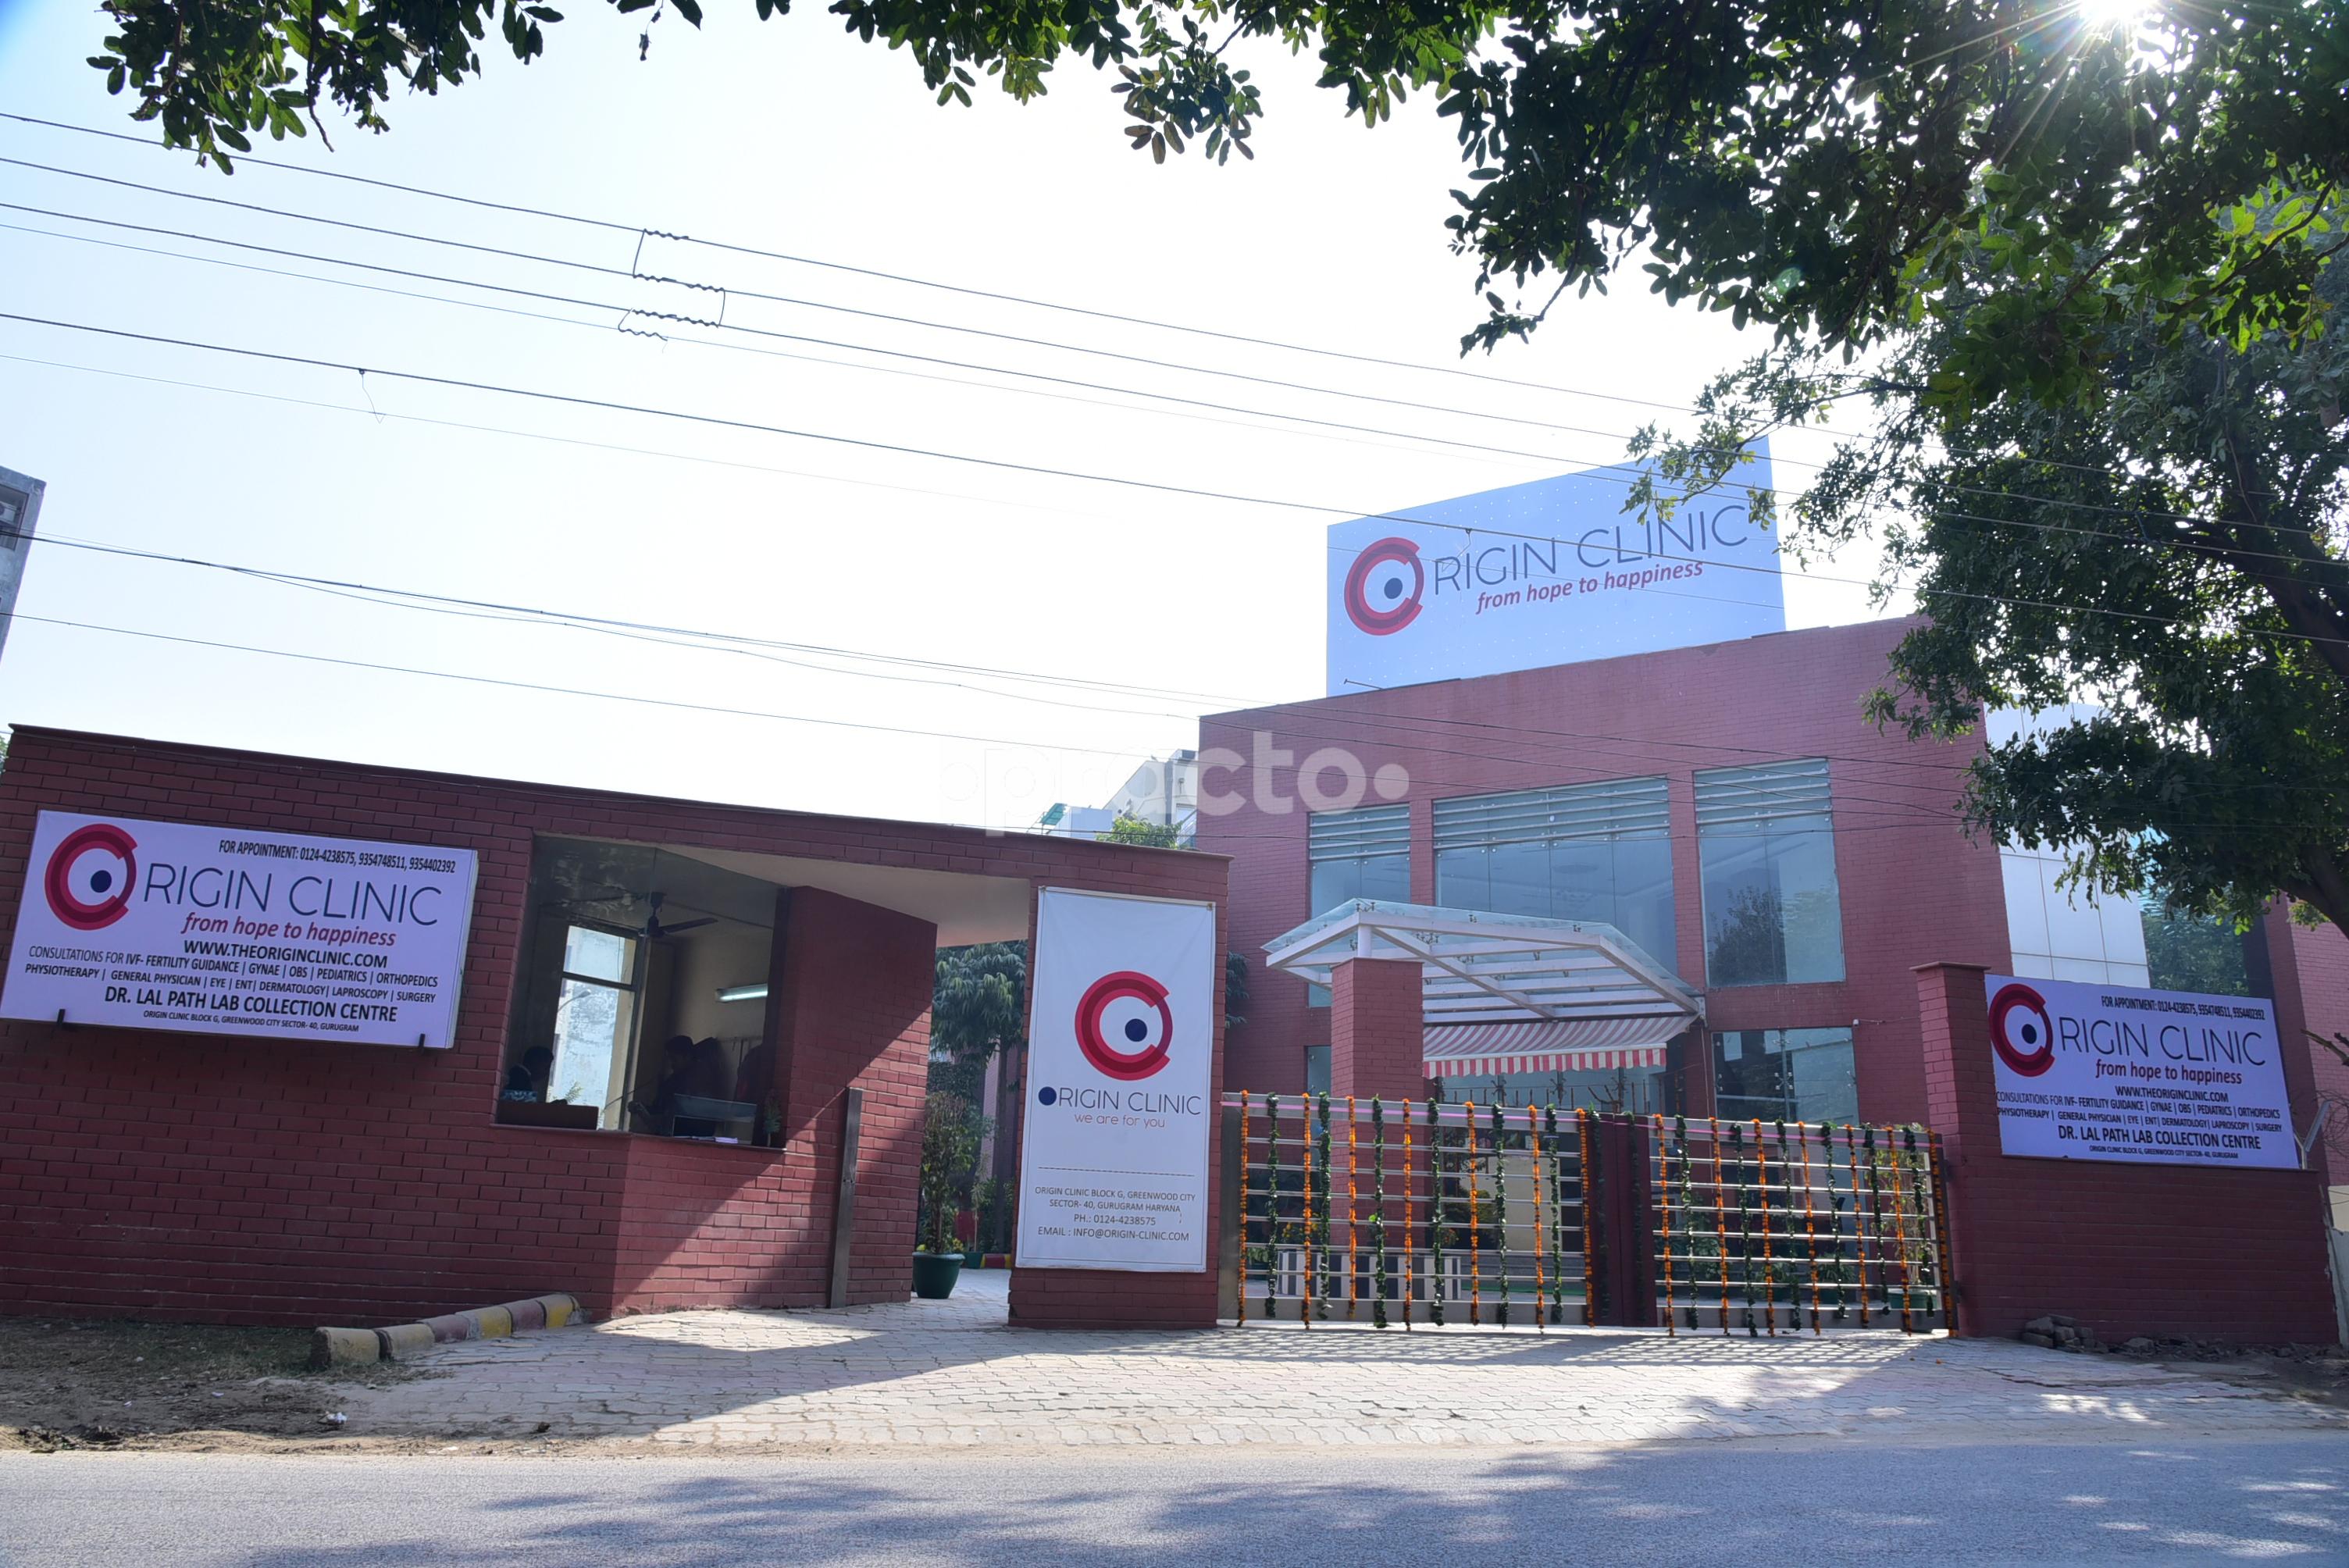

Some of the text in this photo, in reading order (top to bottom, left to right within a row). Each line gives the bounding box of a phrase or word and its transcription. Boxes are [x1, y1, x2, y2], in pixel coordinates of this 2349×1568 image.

[1577, 505, 1748, 568] CLINIC
[1475, 561, 1703, 615] from hope to happiness
[219, 839, 456, 874] FOR APPOINTMENT: 0124-4238575, 9354748511, 9354402392
[289, 875, 442, 926] CLINIC
[180, 911, 397, 947] from hope to happiness
[29, 945, 104, 963] CONSULTATIONS
[105, 951, 124, 964] FOR
[125, 953, 144, 965] IVF-
[145, 954, 191, 969] FERTILITY
[191, 957, 241, 973] GUIDANCE
[248, 963, 280, 976] GYNAE
[289, 965, 308, 978] OBS
[316, 968, 368, 982] PEDIATRICS
[376, 972, 438, 988] ORTHOPEDICS
[184, 939, 388, 969] WWW.THEORIGINCLINIC.COM
[25, 963, 100, 978] PHYSIOTHERAPY
[111, 970, 152, 983] GENERAL
[153, 973, 201, 986] PHYSICIAN
[209, 977, 226, 989] EYE
[332, 986, 389, 1000] LAPROSCOPY
[396, 991, 437, 1003] SURGERY
[105, 985, 398, 1022] DR. LAL PATH LAB COLLECTION CENTRE
[143, 1010, 359, 1032] ORIGIN CLINIC BLOCK G, GREENWOOD CITY SECTOR- 40, GURUGRAM
[2159, 1025, 2266, 1066] CLINIC
[2095, 1058, 2242, 1085] from hope to happiness
[1128, 1092, 1201, 1116] CLINIC
[1996, 1091, 2049, 1105] CONSULTATIONS
[2049, 1095, 2063, 1106] FOR
[2063, 1096, 2078, 1107] IVF-
[2078, 1096, 2109, 1108] FERTILITY
[2110, 1099, 2144, 1111] GUIDANCE
[2150, 1101, 2173, 1113] GYNAE
[2178, 1103, 2191, 1114] OBS
[2197, 1104, 2233, 1116] PEDIATRICS
[2237, 1107, 2281, 1119] ORTHOPEDICS
[2114, 1085, 2229, 1103] WWW.THEORIGINCLINIC.COM
[1074, 1114, 1165, 1129] we are for you
[1998, 1107, 2050, 1119] PHYSIOTHERAPY
[2057, 1110, 2087, 1121] GENERAL
[2087, 1112, 2122, 1123] PHYSICIAN
[2127, 1115, 2140, 1124] EYE
[2211, 1120, 2250, 1130] LAPROSCOPY
[2255, 1123, 2282, 1132] SURGERY
[2058, 1124, 2262, 1149] DR. LAL PATH LAB COLLECTION CENTRE
[1035, 1186, 1196, 1202] ORIGIN CLINIC BLOCK G, GREENWOOD CITY
[1049, 1199, 1181, 1213] SECTOR- 40, GURUGRAM HARYANA
[1093, 1214, 1156, 1226] 0124-4238575
[1038, 1226, 1066, 1236] EMAIL
[1073, 1228, 1189, 1242] INFO@ORIGIN-CLINIC.COM
